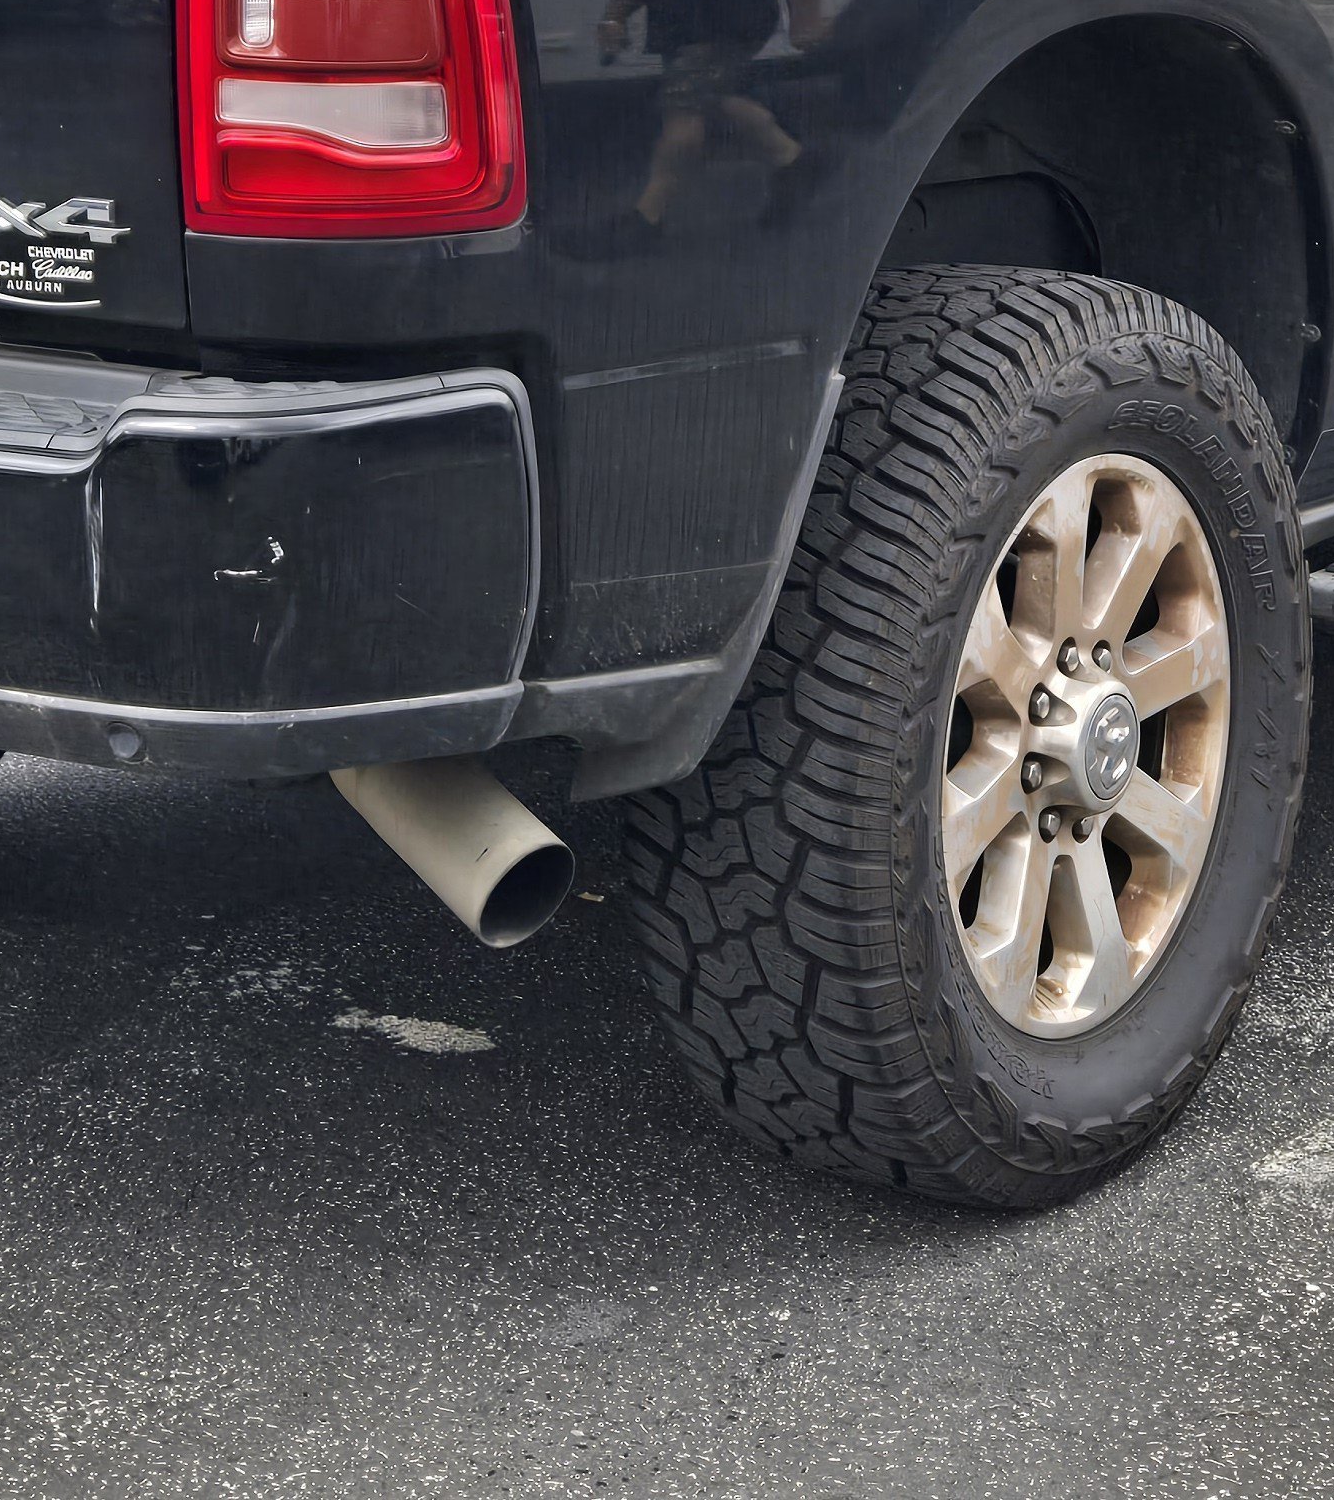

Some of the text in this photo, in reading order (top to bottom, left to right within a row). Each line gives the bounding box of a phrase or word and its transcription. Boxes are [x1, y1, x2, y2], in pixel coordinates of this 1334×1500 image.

[27, 245, 95, 261] CHEVROLET
[31, 259, 94, 280] Cadillac
[7, 279, 63, 293] AUBURN
